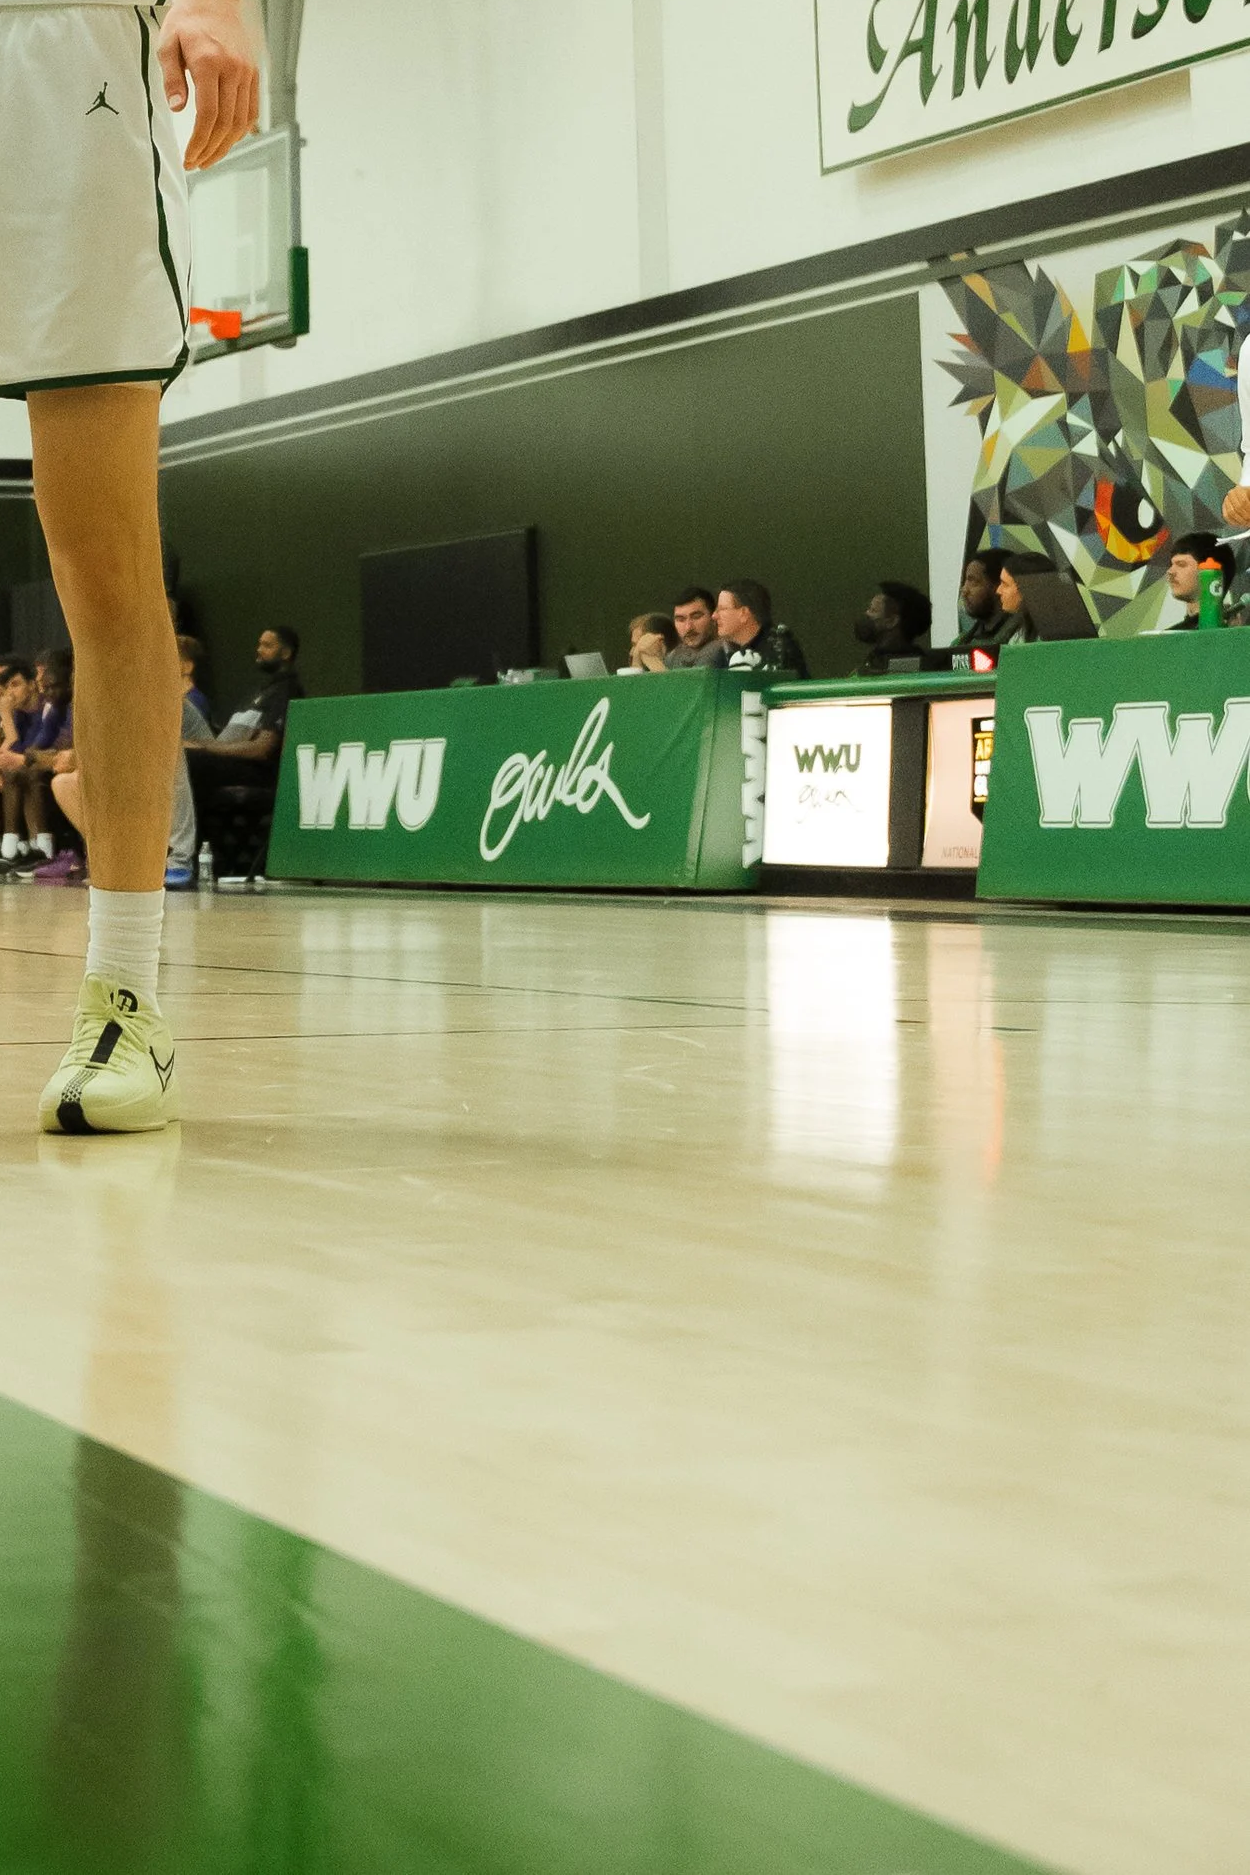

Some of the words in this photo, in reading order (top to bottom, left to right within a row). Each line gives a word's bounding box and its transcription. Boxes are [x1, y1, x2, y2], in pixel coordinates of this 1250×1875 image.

[296, 737, 447, 832] WWU
[793, 743, 862, 774] WWU
[1024, 696, 1250, 829] WW
